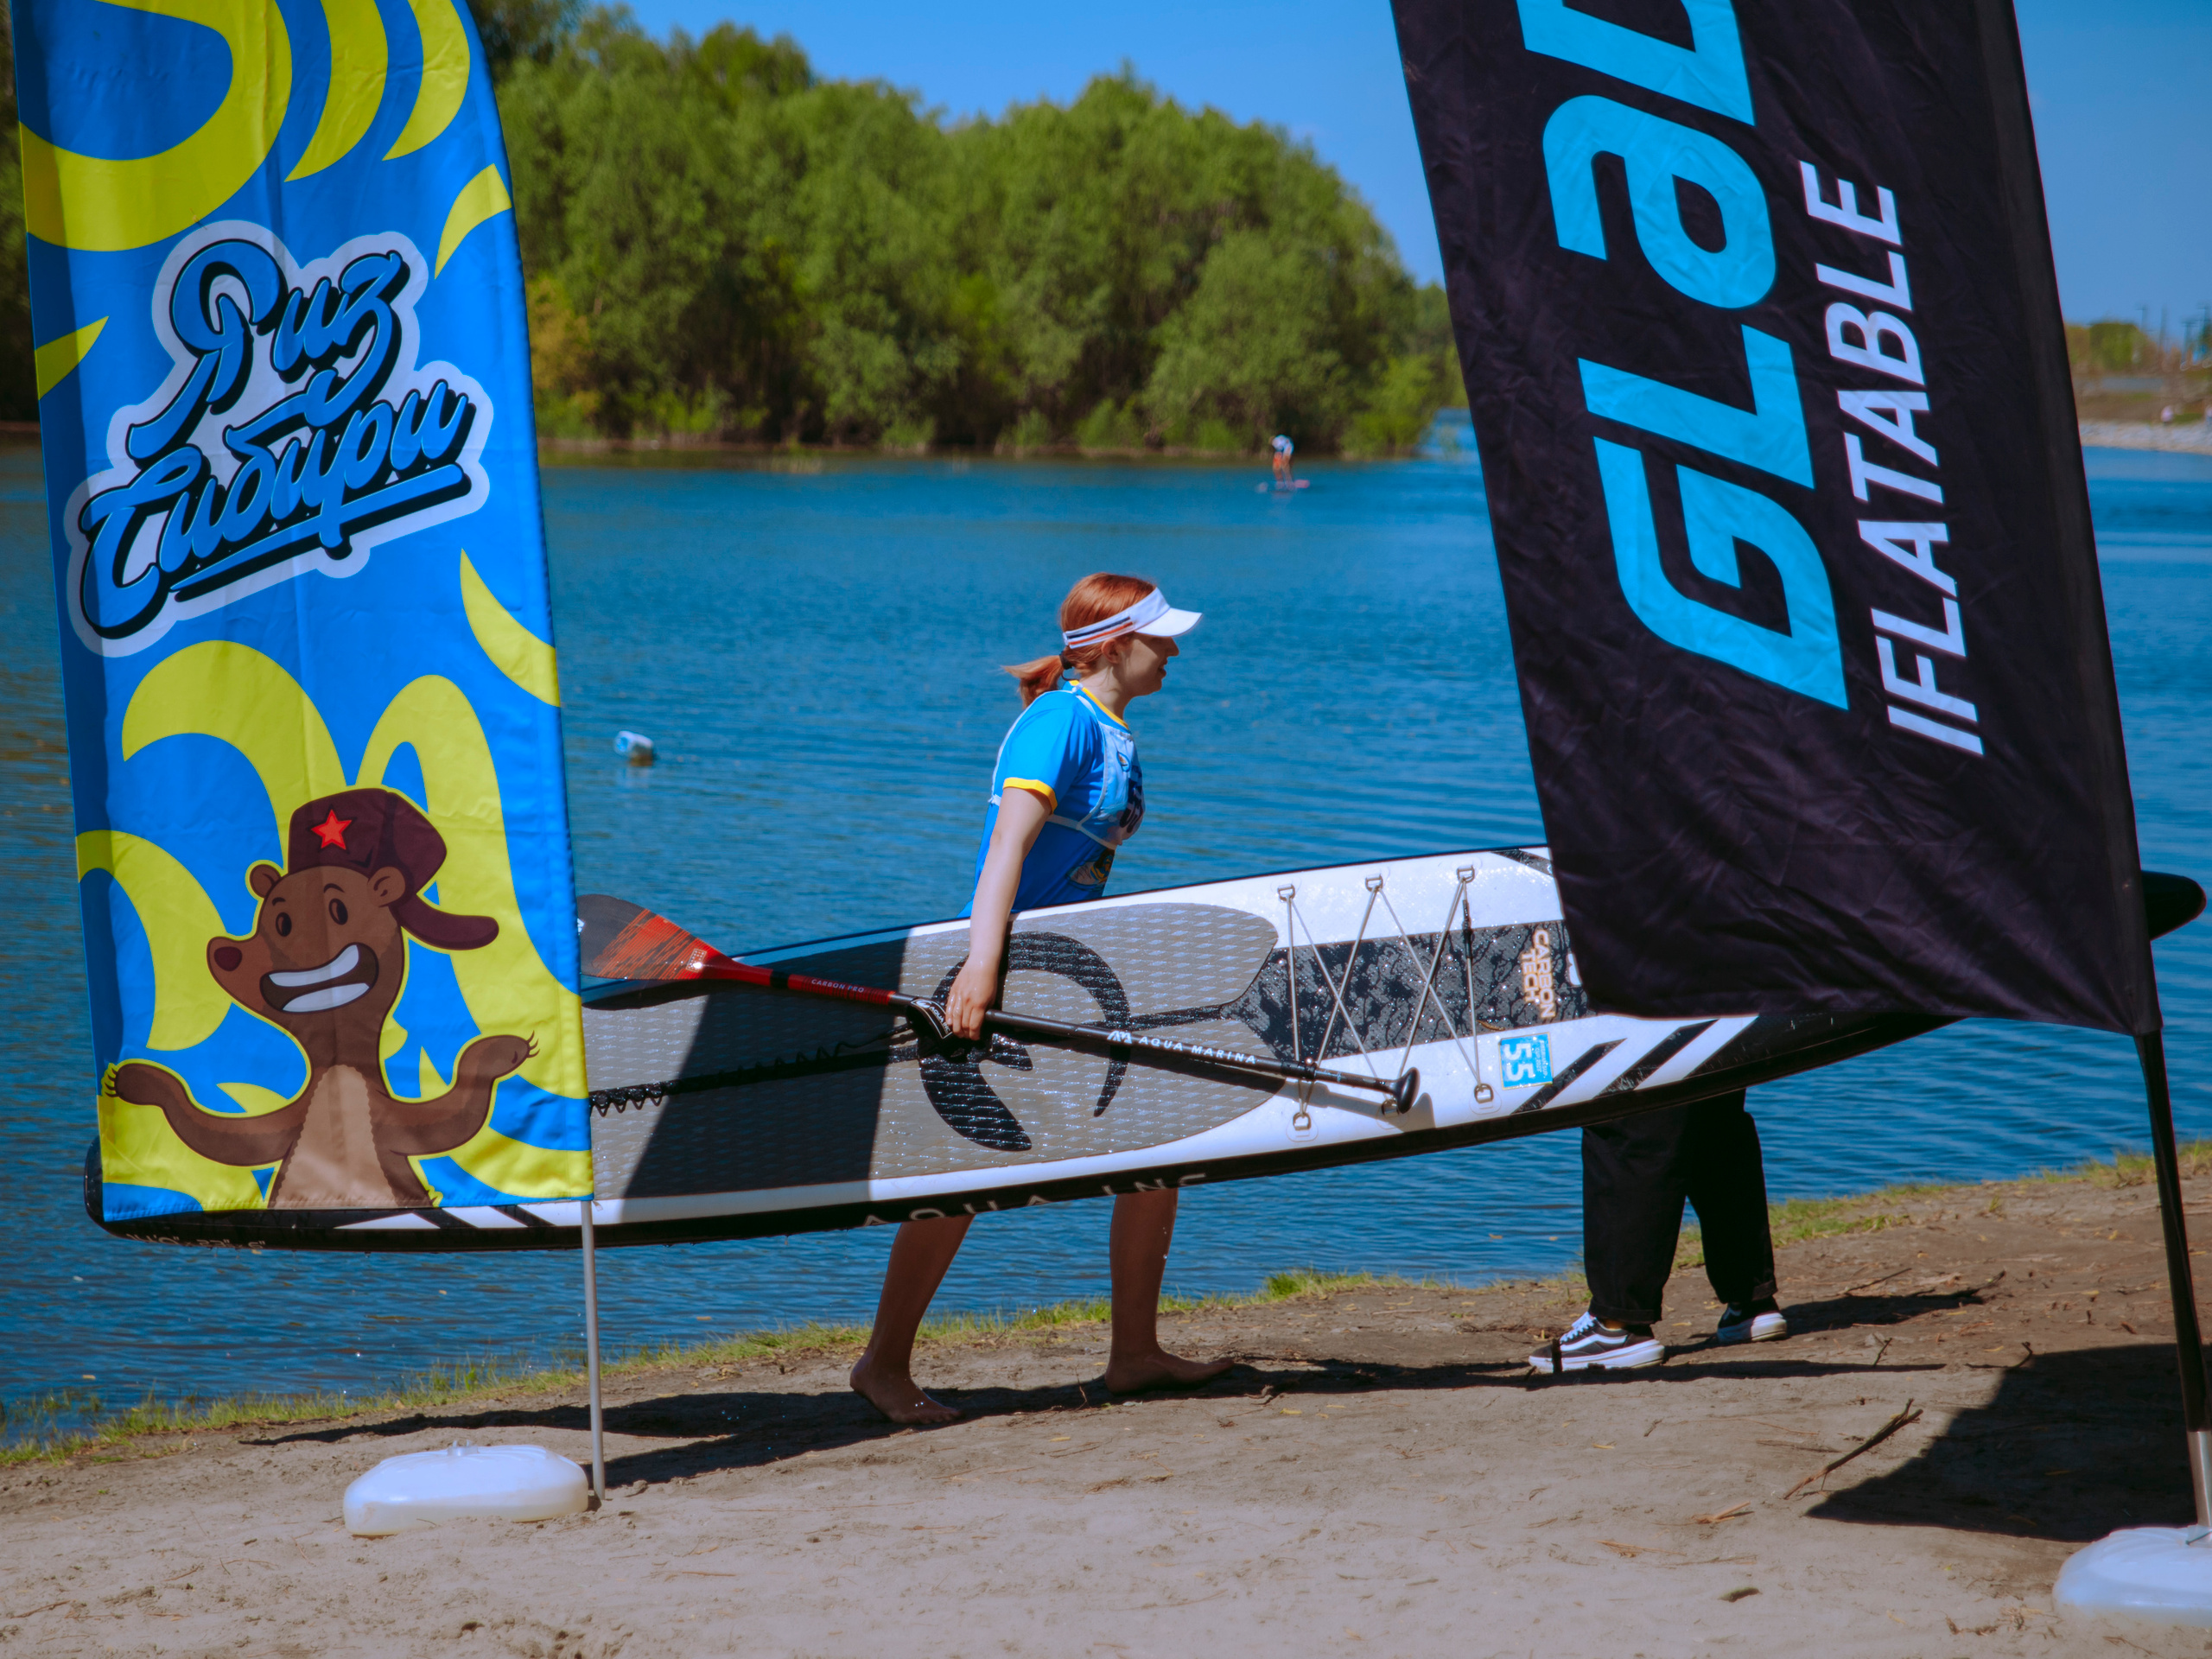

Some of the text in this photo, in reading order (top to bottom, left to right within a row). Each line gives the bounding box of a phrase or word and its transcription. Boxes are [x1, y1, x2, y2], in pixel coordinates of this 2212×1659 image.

[1799, 160, 1984, 756] IFLATABLE
[79, 378, 476, 640] Сибири
[811, 978, 845, 990] CARBON
[1522, 948, 1541, 1002] TECH
[1534, 929, 1555, 1018] CARBON
[1138, 1035, 1256, 1065] AQUA MARINA
[1503, 1042, 1535, 1082] 55
